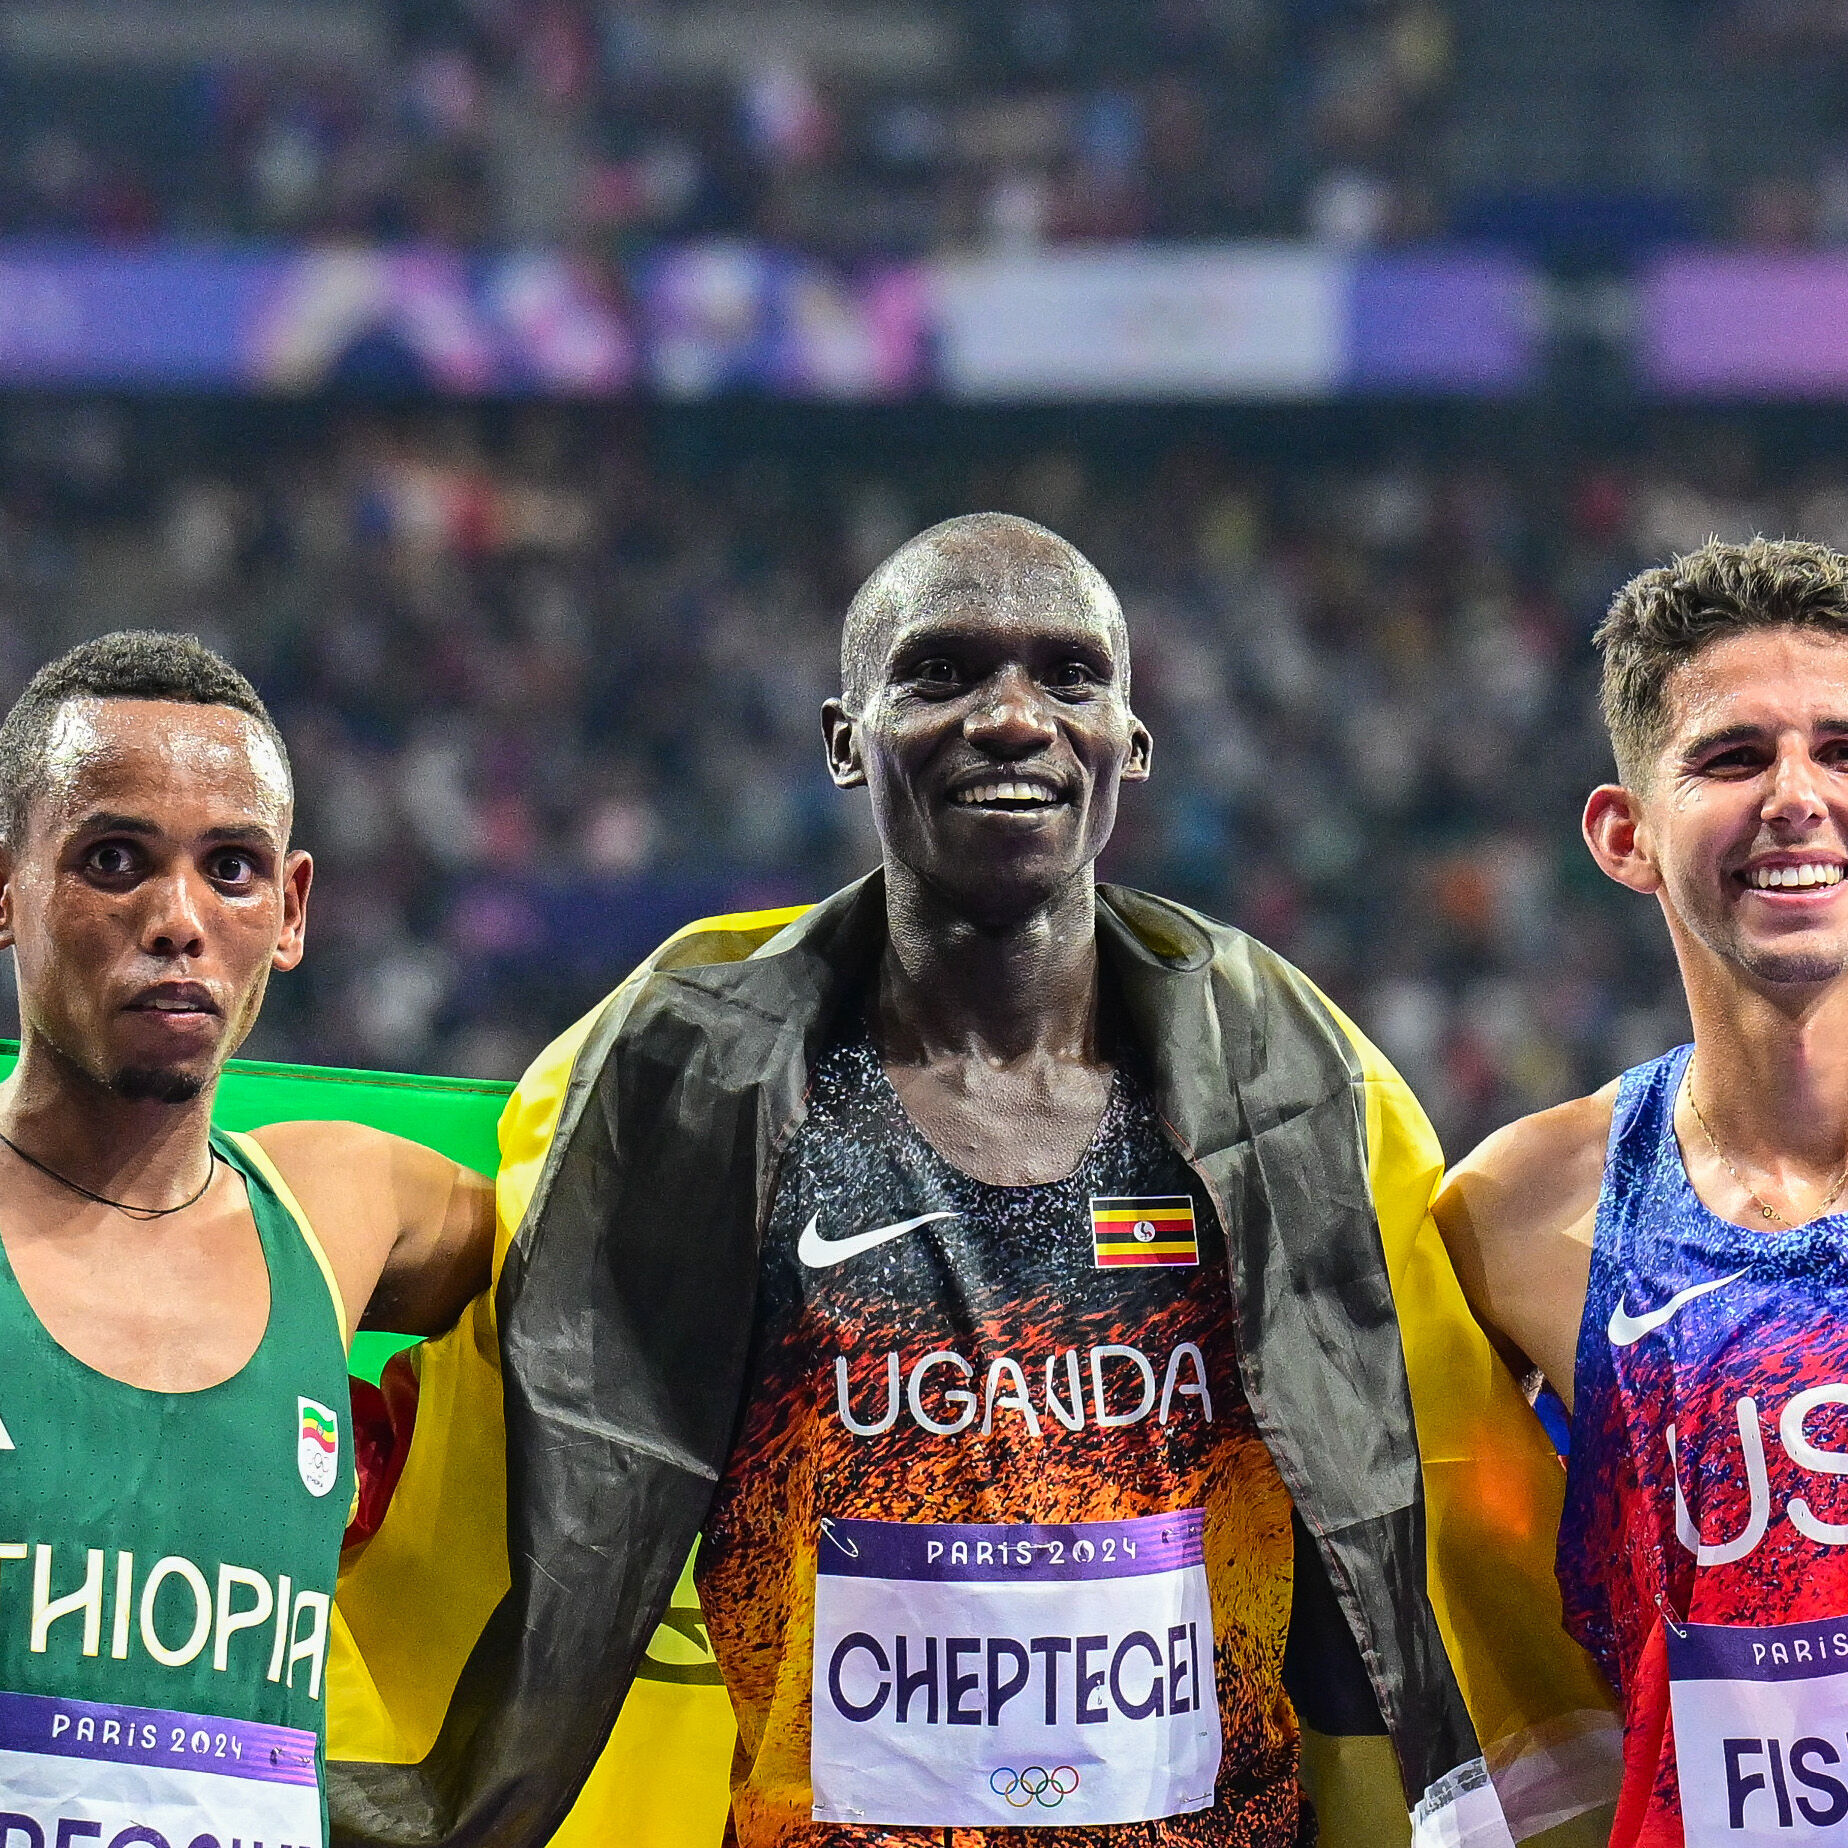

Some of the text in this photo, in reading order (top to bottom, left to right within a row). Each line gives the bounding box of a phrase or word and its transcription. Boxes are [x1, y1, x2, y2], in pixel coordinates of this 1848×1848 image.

[835, 1342, 1213, 1438] UGANDA
[1049, 1536, 1137, 1566] 2024
[827, 1622, 1201, 1727] CHEPTEGEI
[170, 1727, 243, 1760] 2024
